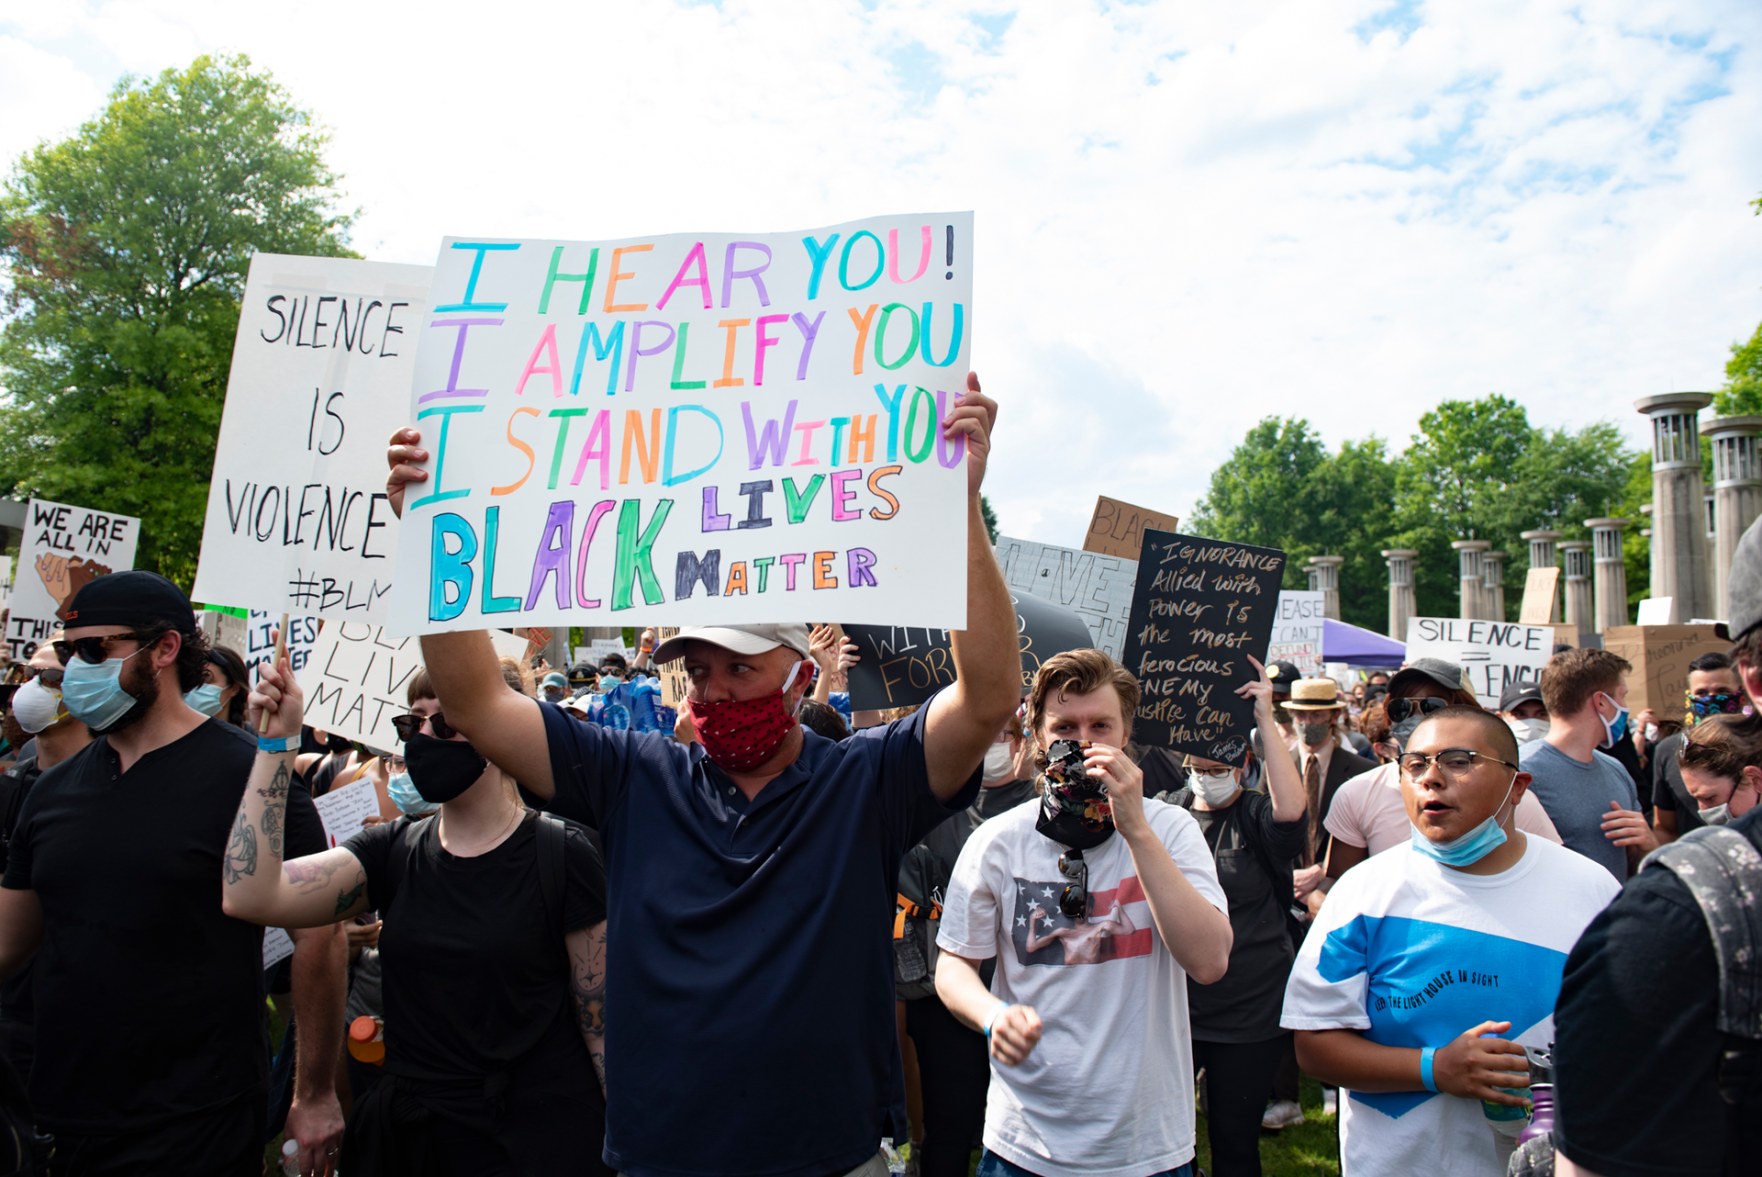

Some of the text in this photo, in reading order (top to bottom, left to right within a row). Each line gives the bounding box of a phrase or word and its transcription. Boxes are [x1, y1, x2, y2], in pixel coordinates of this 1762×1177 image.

[433, 225, 954, 315] I HEAR YOU!
[260, 294, 409, 357] SILENCE
[418, 302, 963, 404] I AMPLIFY YOU
[308, 387, 345, 455] IS
[410, 383, 967, 510] I STAND WITH YOU
[34, 503, 129, 541] WE ARE
[226, 479, 388, 558] VIOLENCE
[701, 465, 903, 533] LIVES
[1091, 499, 1163, 548] BLAC
[35, 529, 111, 556] ALL IN
[428, 497, 879, 624] BLACK MATTER
[1149, 566, 1262, 596] Allied with
[1138, 623, 1171, 647] the
[1189, 628, 1253, 649] most
[1418, 619, 1543, 651] SILENCE
[1137, 650, 1235, 677] ferocious
[1388, 995, 1402, 1009] THE
[1458, 969, 1468, 983] IN
[1471, 971, 1499, 988] SIGHT
